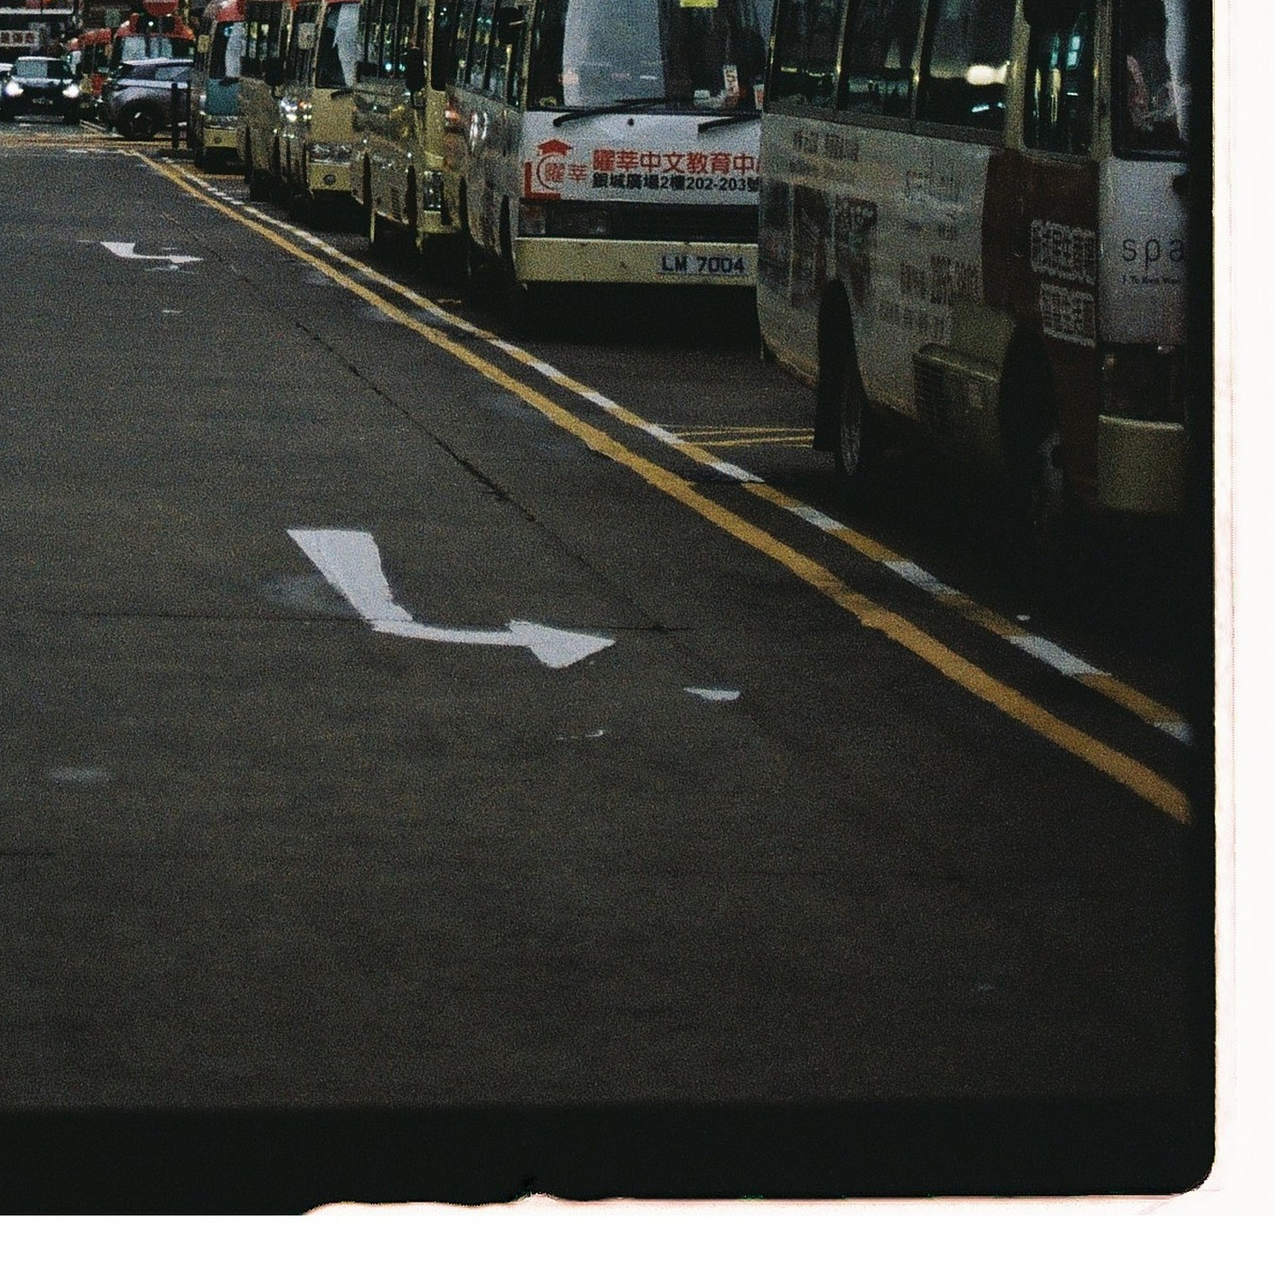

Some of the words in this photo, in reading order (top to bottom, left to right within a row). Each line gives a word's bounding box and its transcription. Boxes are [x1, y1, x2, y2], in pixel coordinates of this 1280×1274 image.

[661, 256, 687, 273] LM
[697, 256, 745, 274] 7004
[1122, 238, 1184, 271] spa
